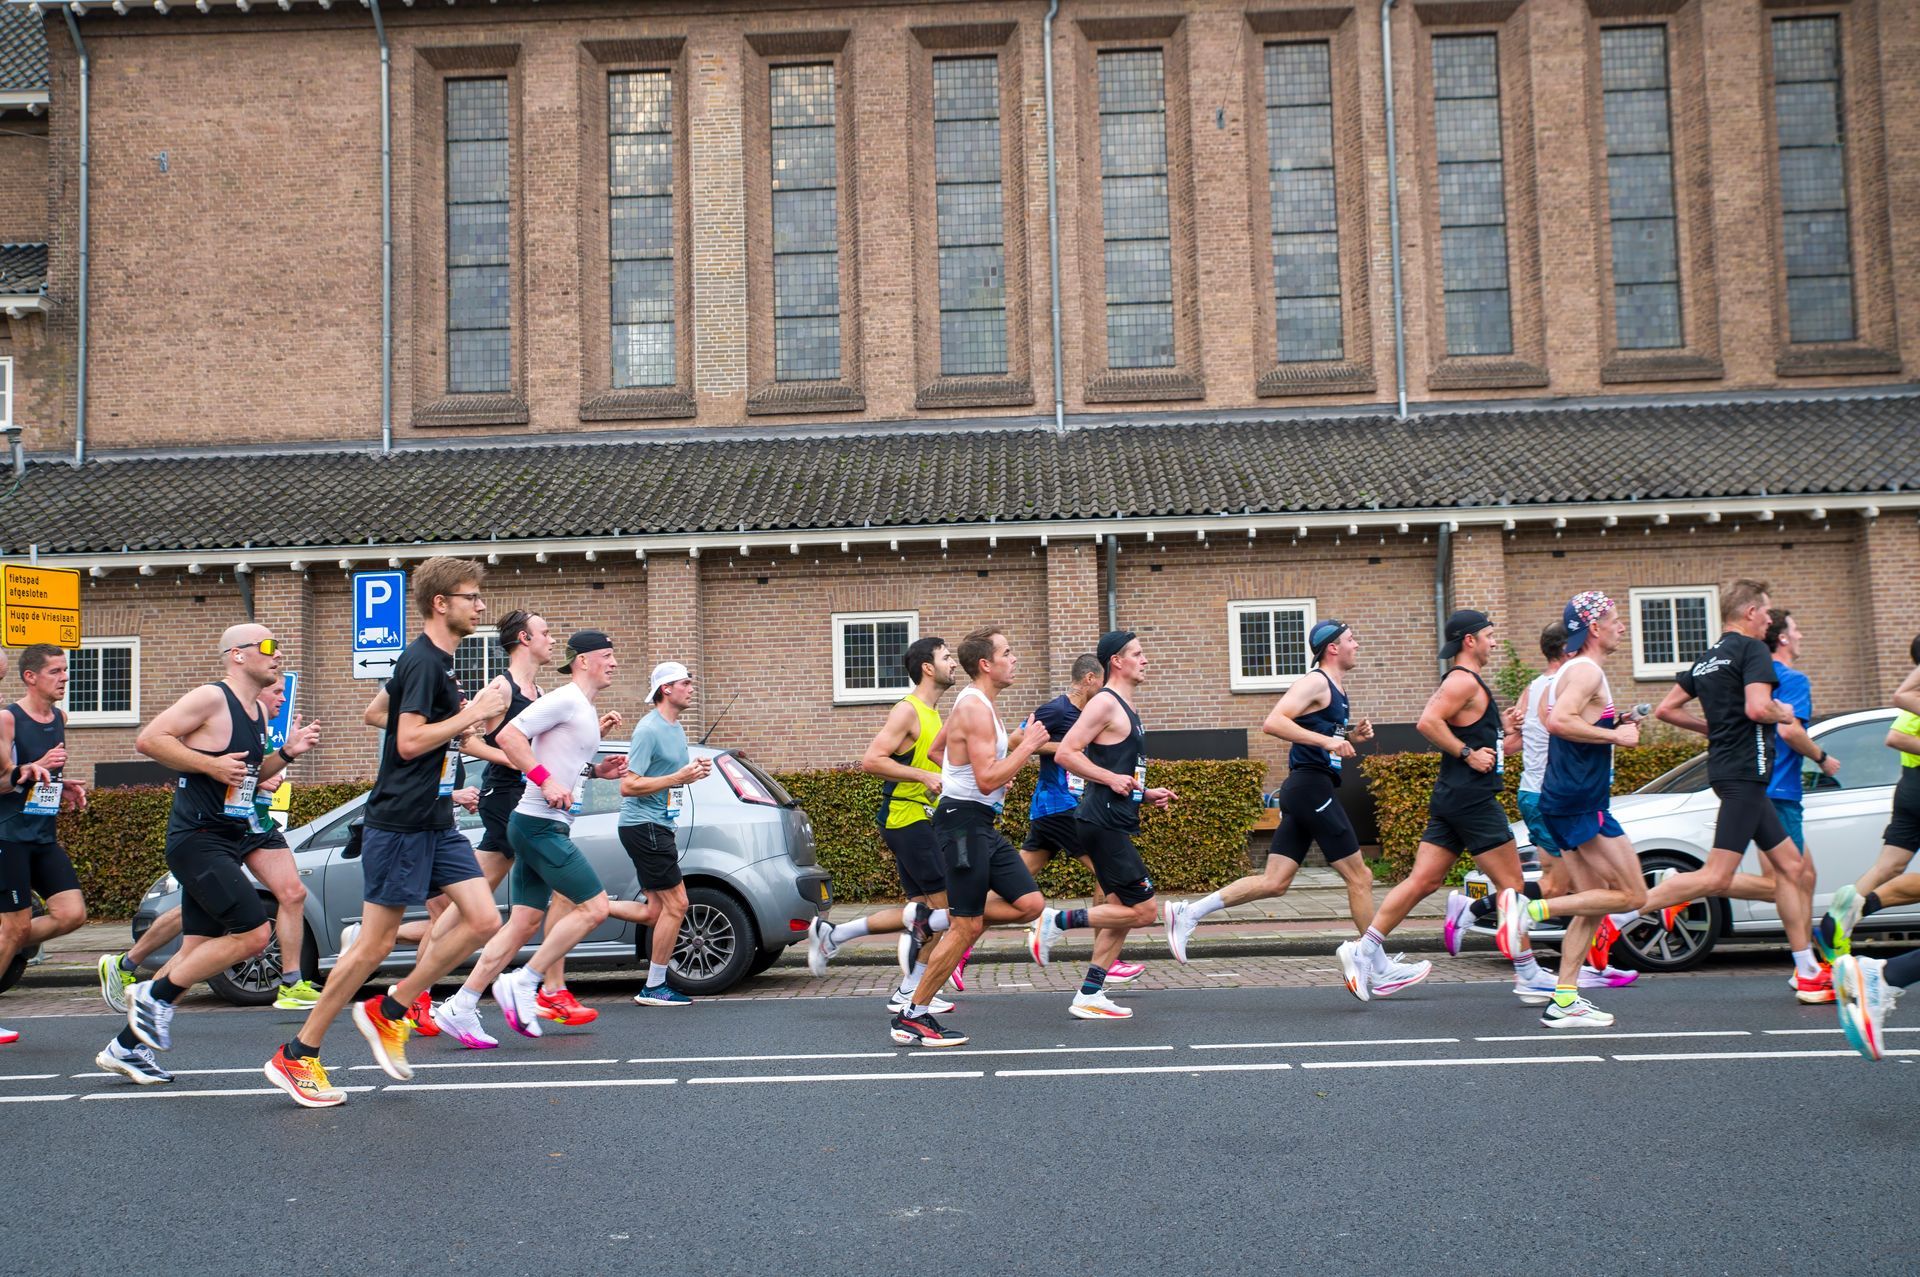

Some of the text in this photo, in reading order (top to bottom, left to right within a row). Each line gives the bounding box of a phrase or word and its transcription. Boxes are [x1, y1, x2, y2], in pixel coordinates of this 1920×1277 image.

[9, 574, 39, 585] fietspad
[9, 587, 48, 599] afgesloten
[365, 580, 392, 619] P
[10, 610, 75, 623] Hugo de Vrieslaan
[10, 624, 26, 636] volg
